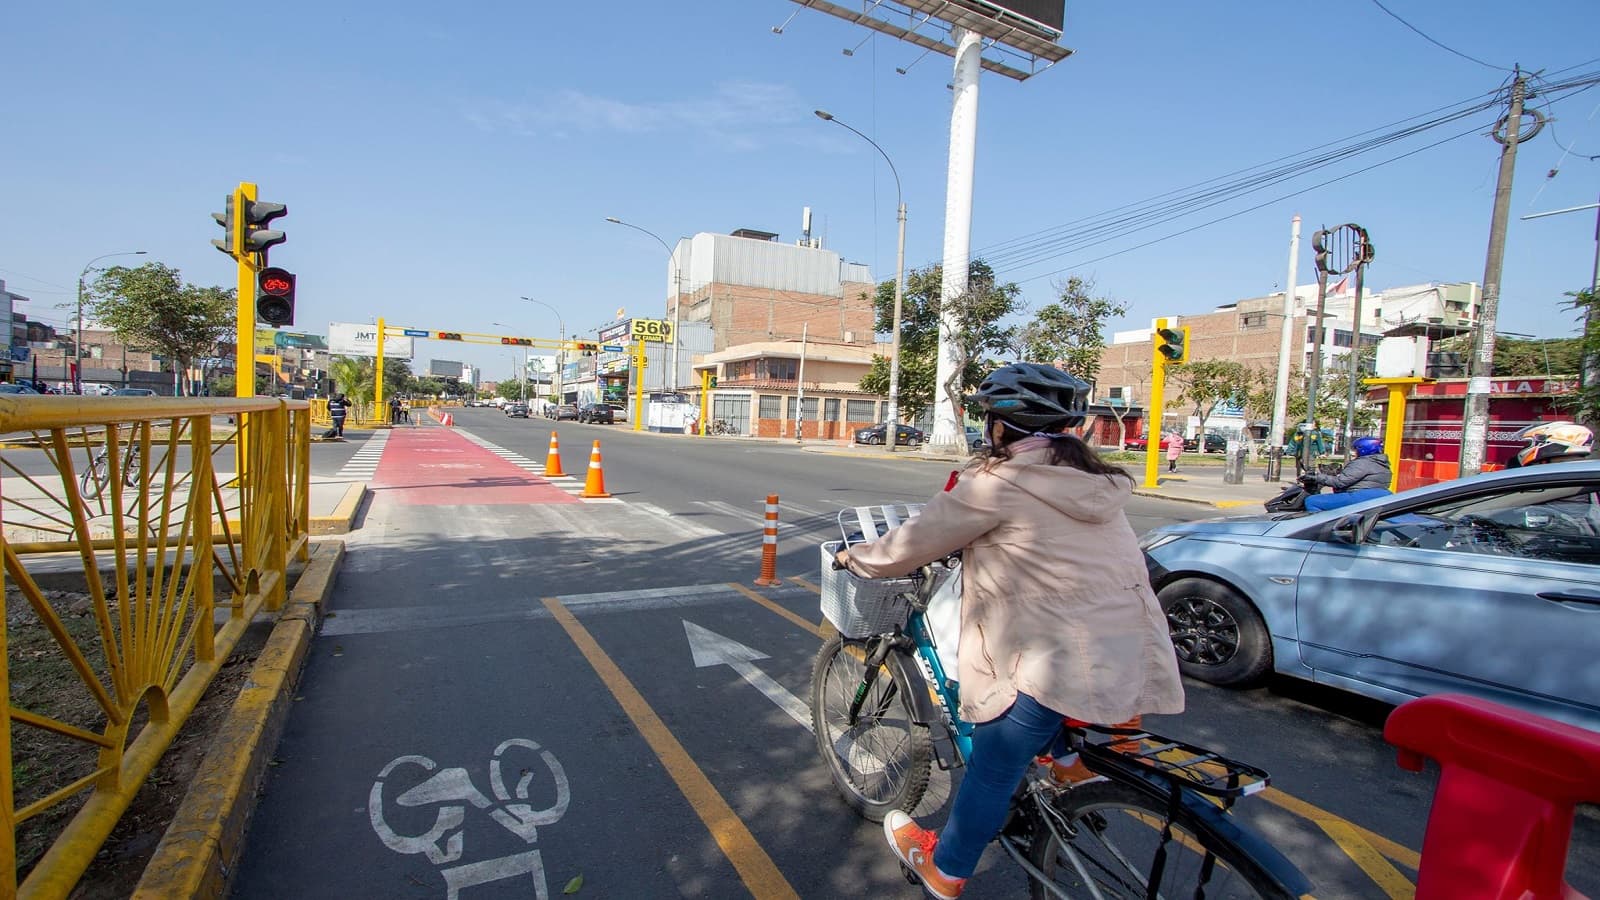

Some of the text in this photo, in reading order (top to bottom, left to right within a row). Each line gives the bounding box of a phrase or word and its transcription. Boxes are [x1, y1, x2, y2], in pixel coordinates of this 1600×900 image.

[354, 332, 376, 340] JMT
[633, 355, 647, 363] 50
[923, 656, 960, 736] TOP BIKE
